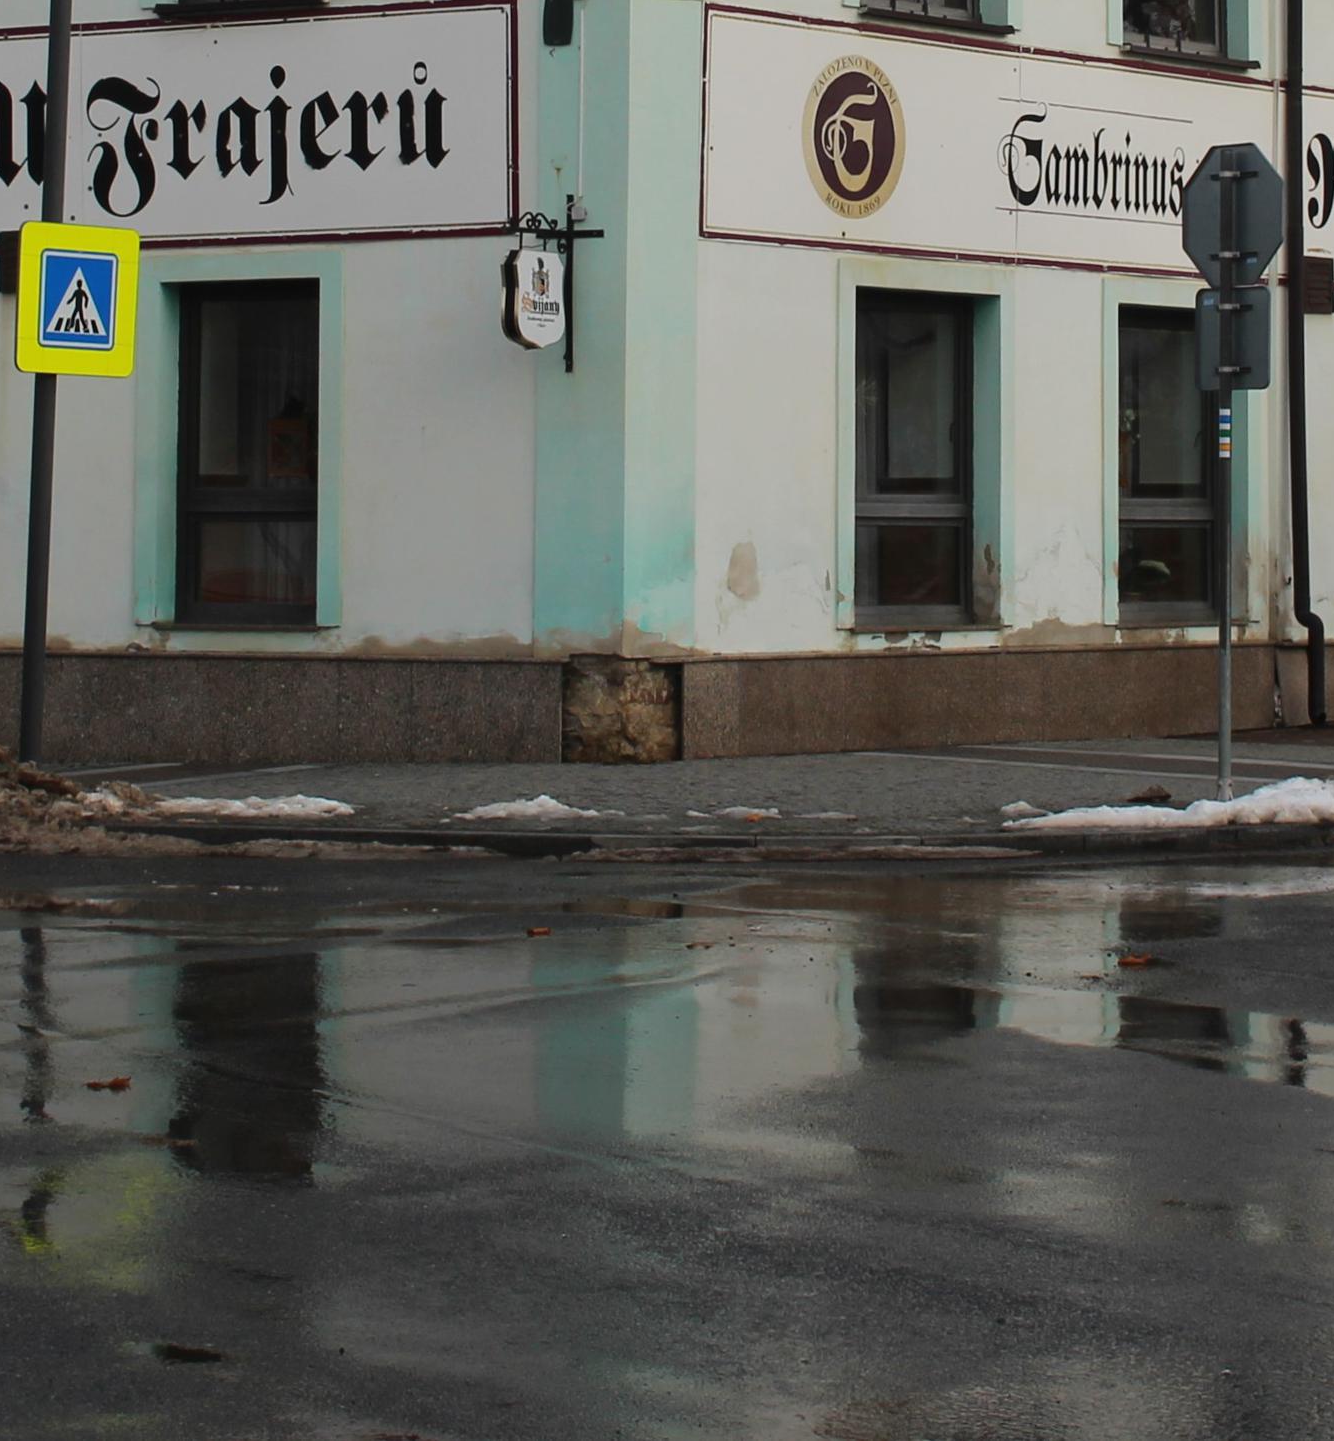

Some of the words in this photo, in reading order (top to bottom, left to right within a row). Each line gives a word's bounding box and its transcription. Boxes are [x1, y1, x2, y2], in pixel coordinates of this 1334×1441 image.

[85, 61, 452, 218] Frajerů
[997, 101, 1186, 218] Gambrinus
[858, 195, 882, 216] 1869
